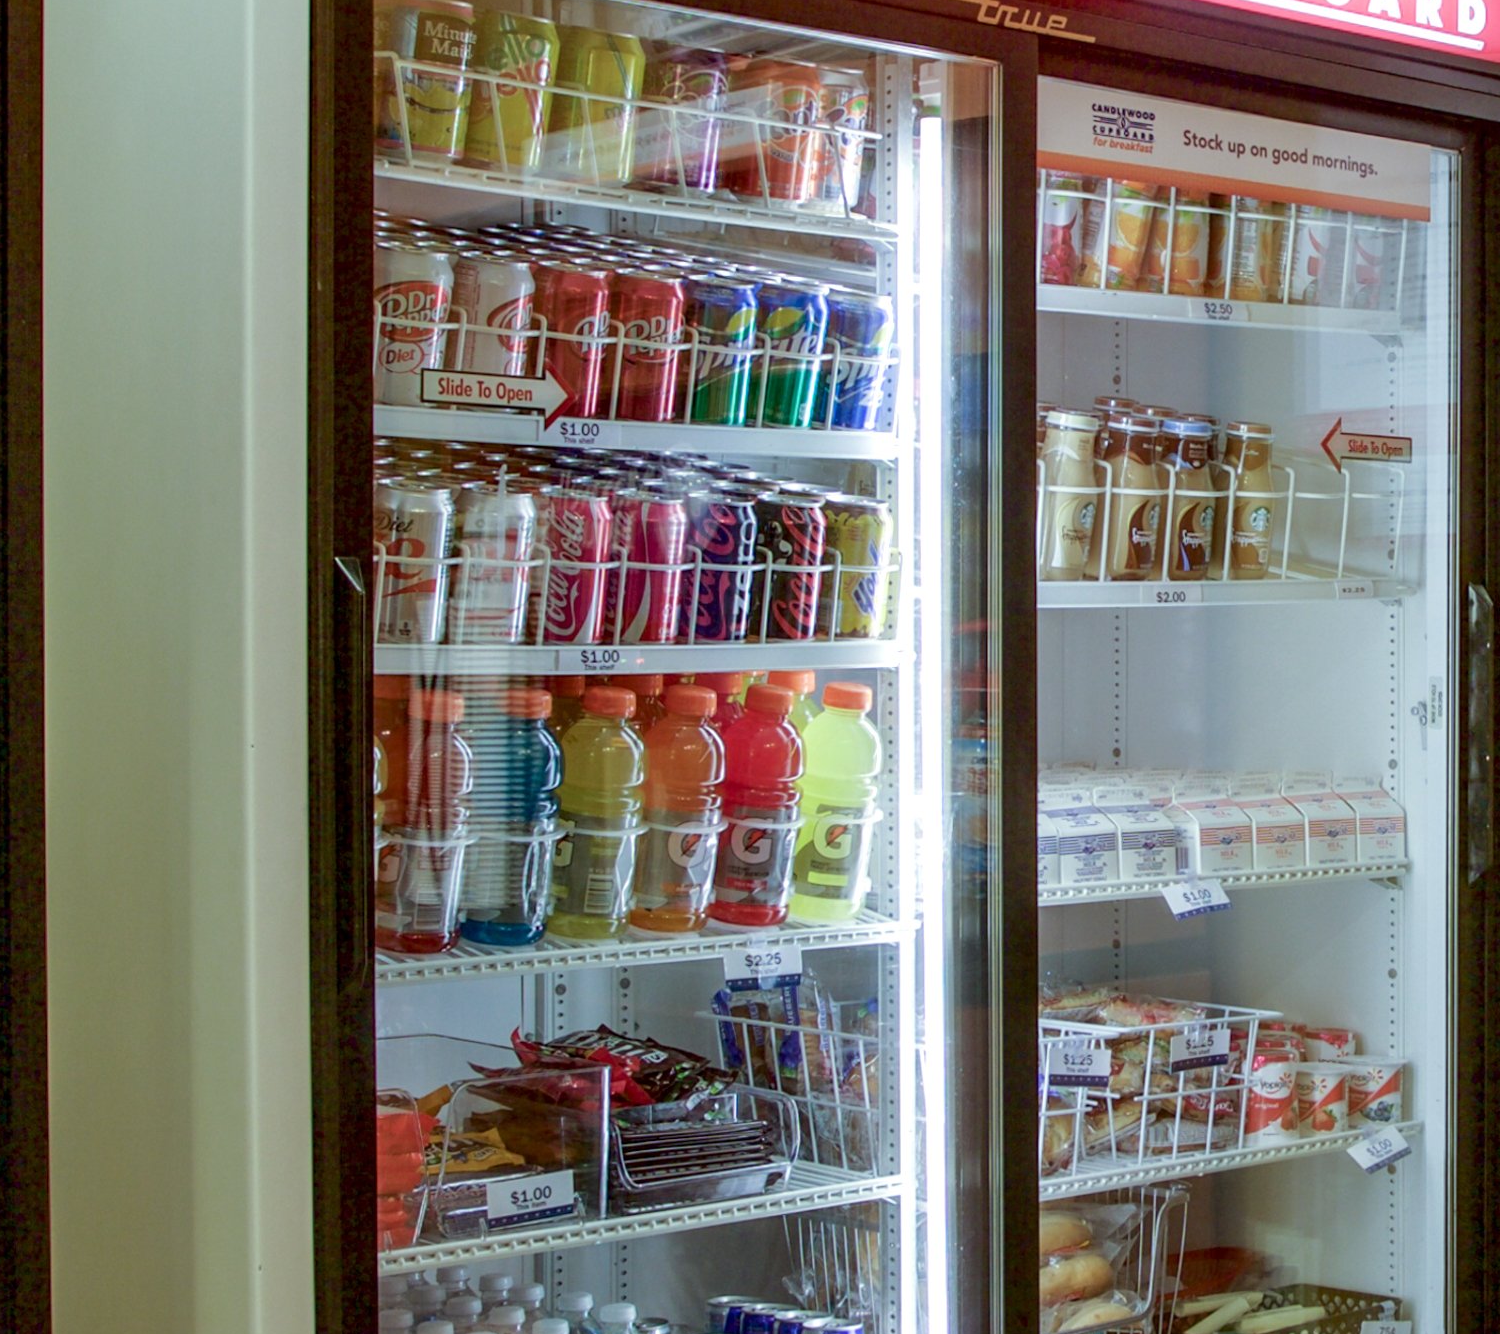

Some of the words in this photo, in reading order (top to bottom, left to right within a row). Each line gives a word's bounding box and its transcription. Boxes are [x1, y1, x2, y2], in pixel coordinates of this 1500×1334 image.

[423, 19, 478, 45] Minute
[431, 37, 474, 60] Maid
[1091, 102, 1156, 121] CANDLEWOOD
[1092, 125, 1155, 142] CUPBOARD
[1108, 137, 1154, 155] breakfast
[1183, 129, 1224, 153] Stock
[1228, 139, 1246, 158] up
[1251, 144, 1269, 158] on
[1272, 144, 1309, 166] good
[1312, 154, 1379, 179] mornings.
[1204, 301, 1234, 317] $2.50
[385, 348, 416, 365] Diet
[438, 379, 472, 400] Slide
[476, 380, 494, 399] To
[496, 381, 533, 403] Open
[559, 421, 600, 439] $1.00
[1347, 438, 1369, 455] Slide
[1370, 439, 1380, 455] To
[1381, 441, 1404, 459] Open
[1156, 589, 1187, 604] $2.00
[580, 649, 621, 666] $1.00
[1181, 887, 1212, 905] $1.00
[744, 952, 782, 968] $2.25
[1366, 1138, 1393, 1157] $1.00
[510, 1185, 553, 1206] $1.00
